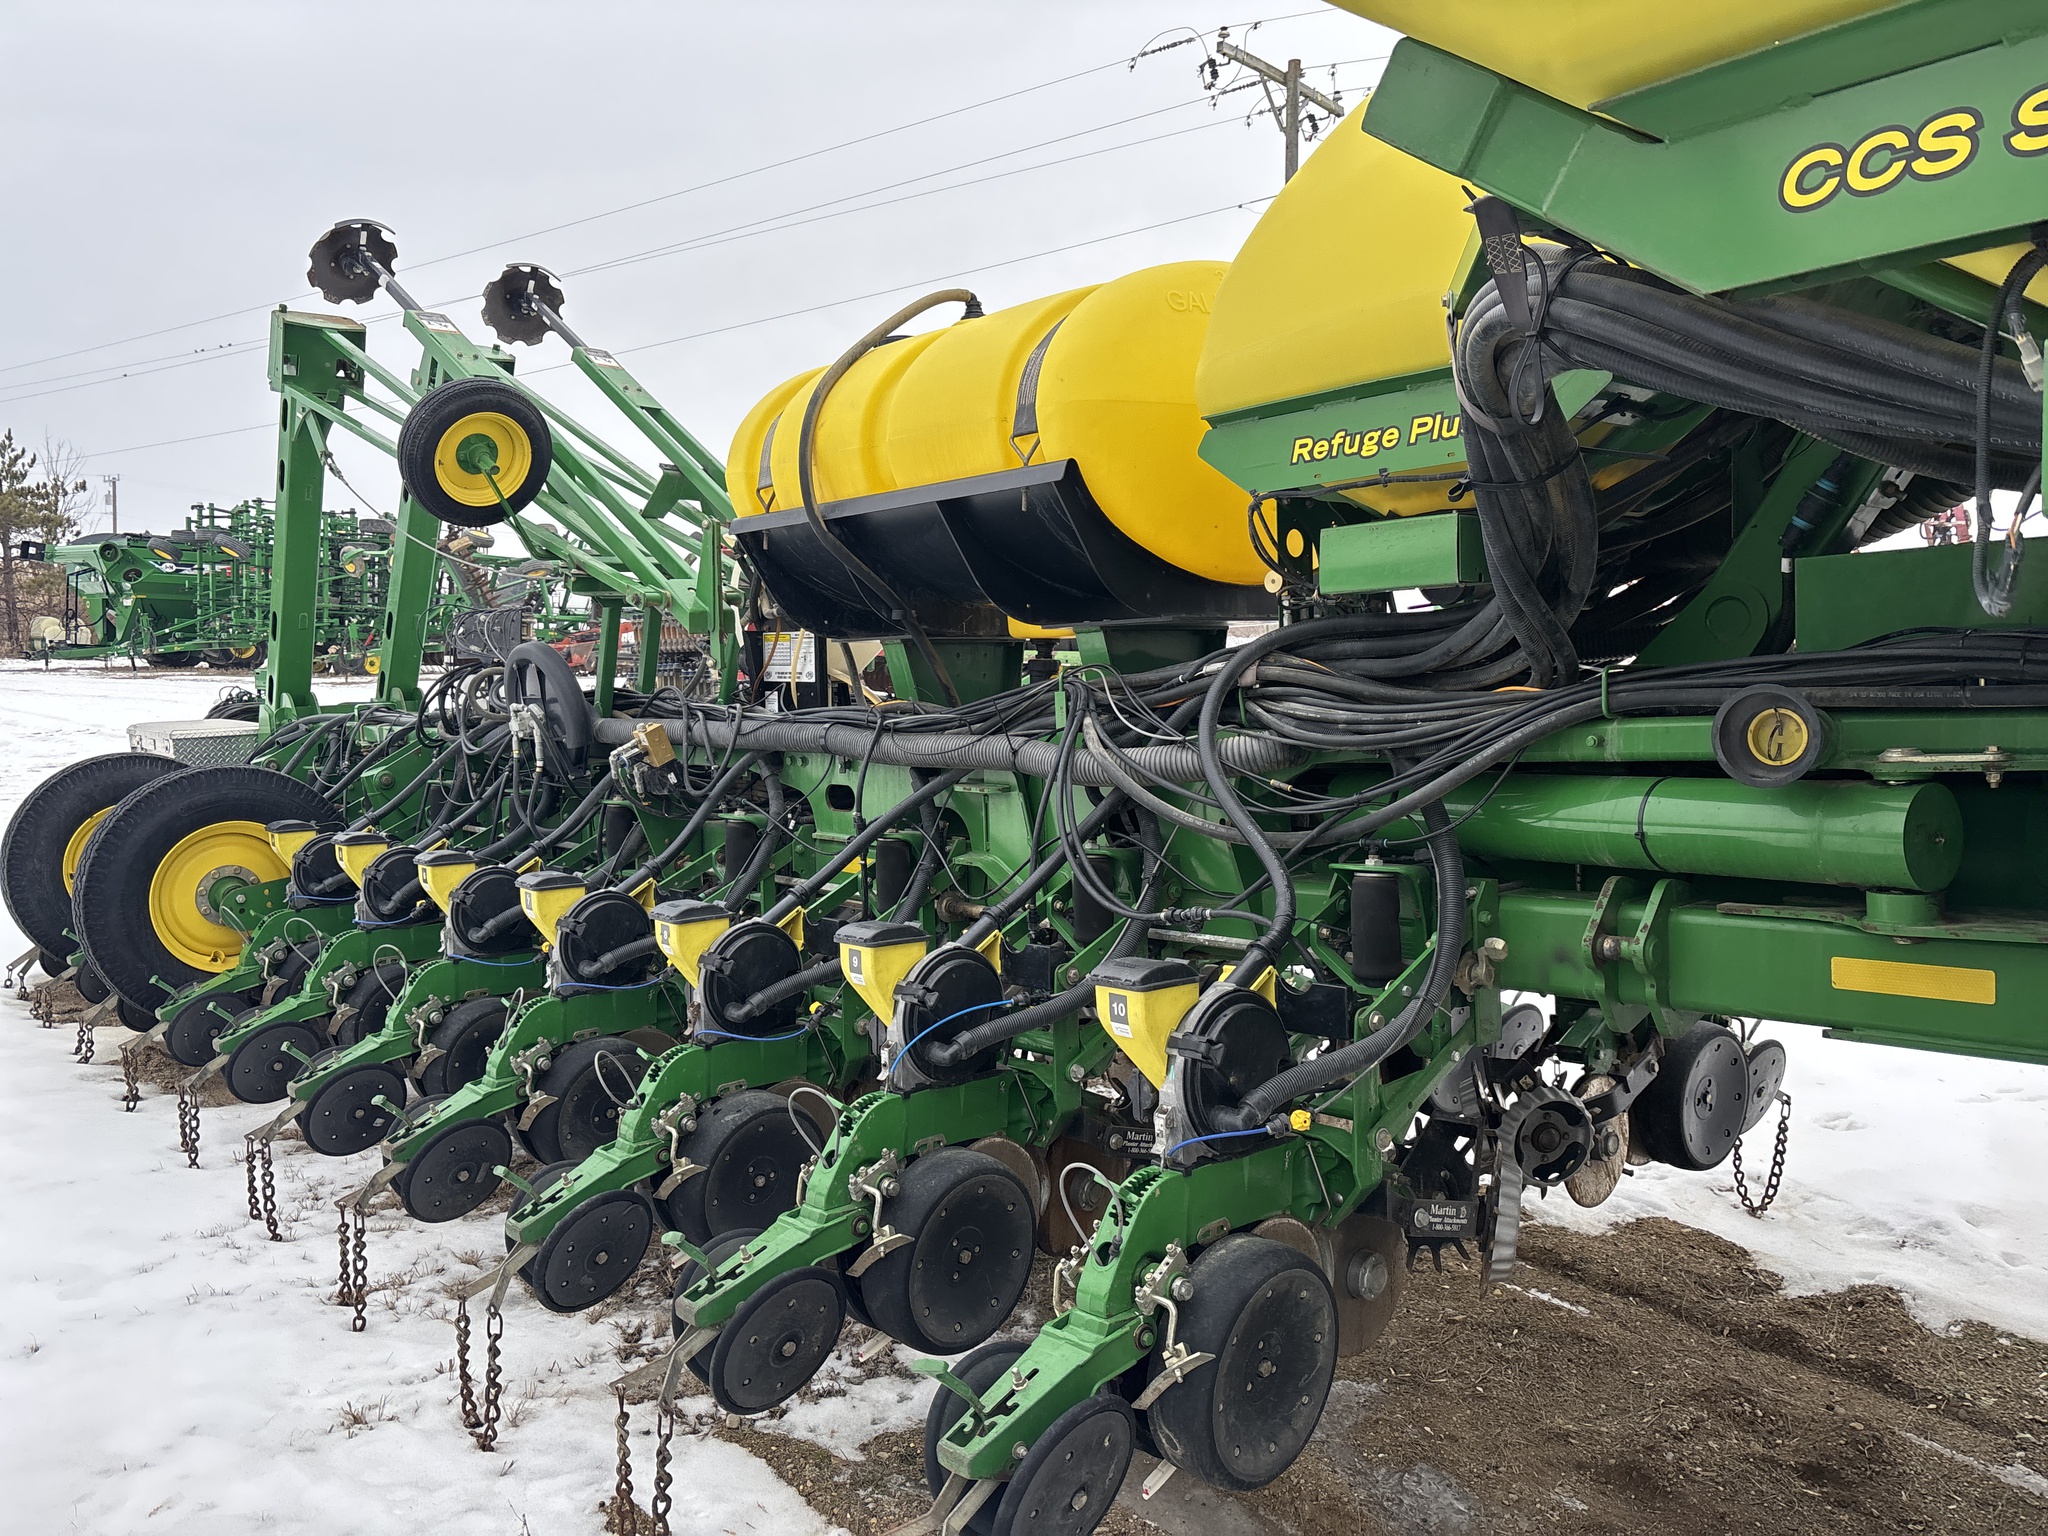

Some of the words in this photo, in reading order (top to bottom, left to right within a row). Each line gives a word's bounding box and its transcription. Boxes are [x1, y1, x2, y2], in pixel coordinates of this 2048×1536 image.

[1779, 107, 1983, 212] CCS
[1290, 426, 1400, 465] Refuge
[1407, 411, 1463, 446] Plu
[663, 930, 668, 940] 8
[852, 956, 858, 968] 9
[1112, 1001, 1126, 1017] 10
[1126, 1131, 1154, 1142] Martin
[1430, 1204, 1457, 1216] Martin
